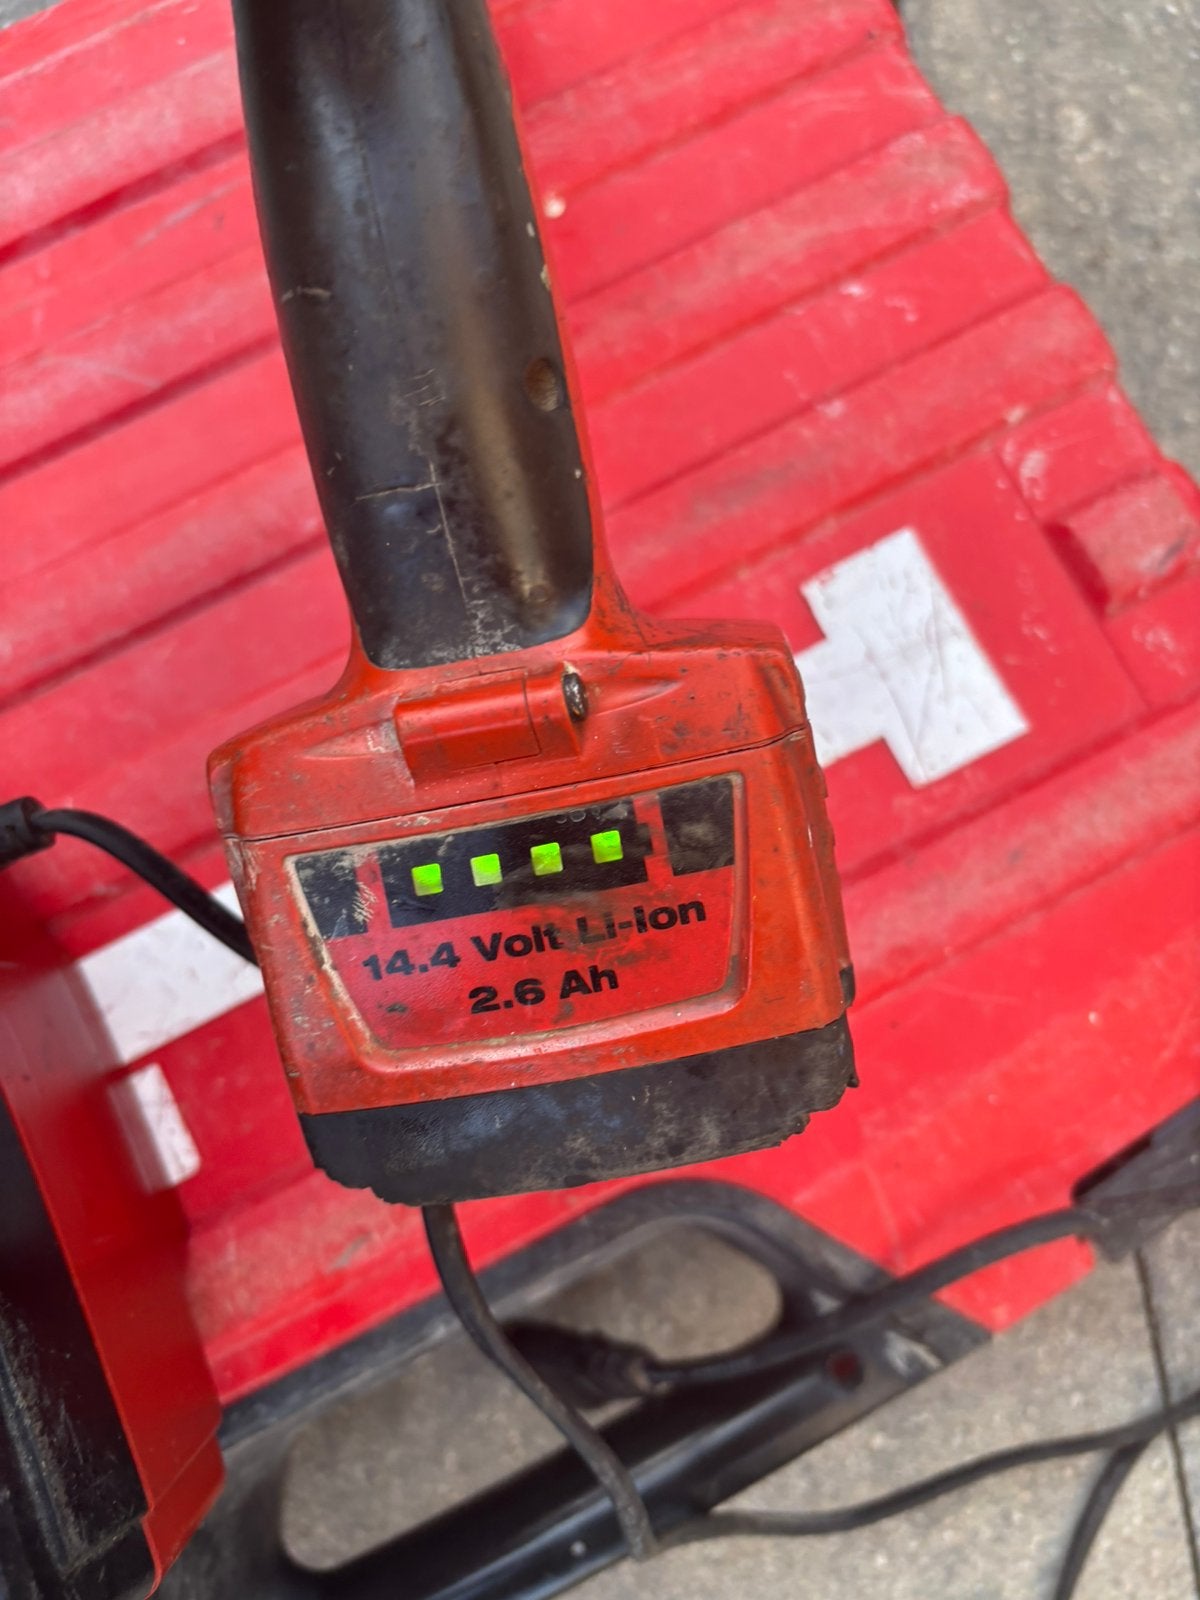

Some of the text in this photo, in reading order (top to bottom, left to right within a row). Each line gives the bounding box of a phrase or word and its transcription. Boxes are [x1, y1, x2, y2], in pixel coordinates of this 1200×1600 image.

[362, 899, 707, 981] 14.4 Volt Li-Ion
[468, 964, 619, 1014] 2.6 Ah
